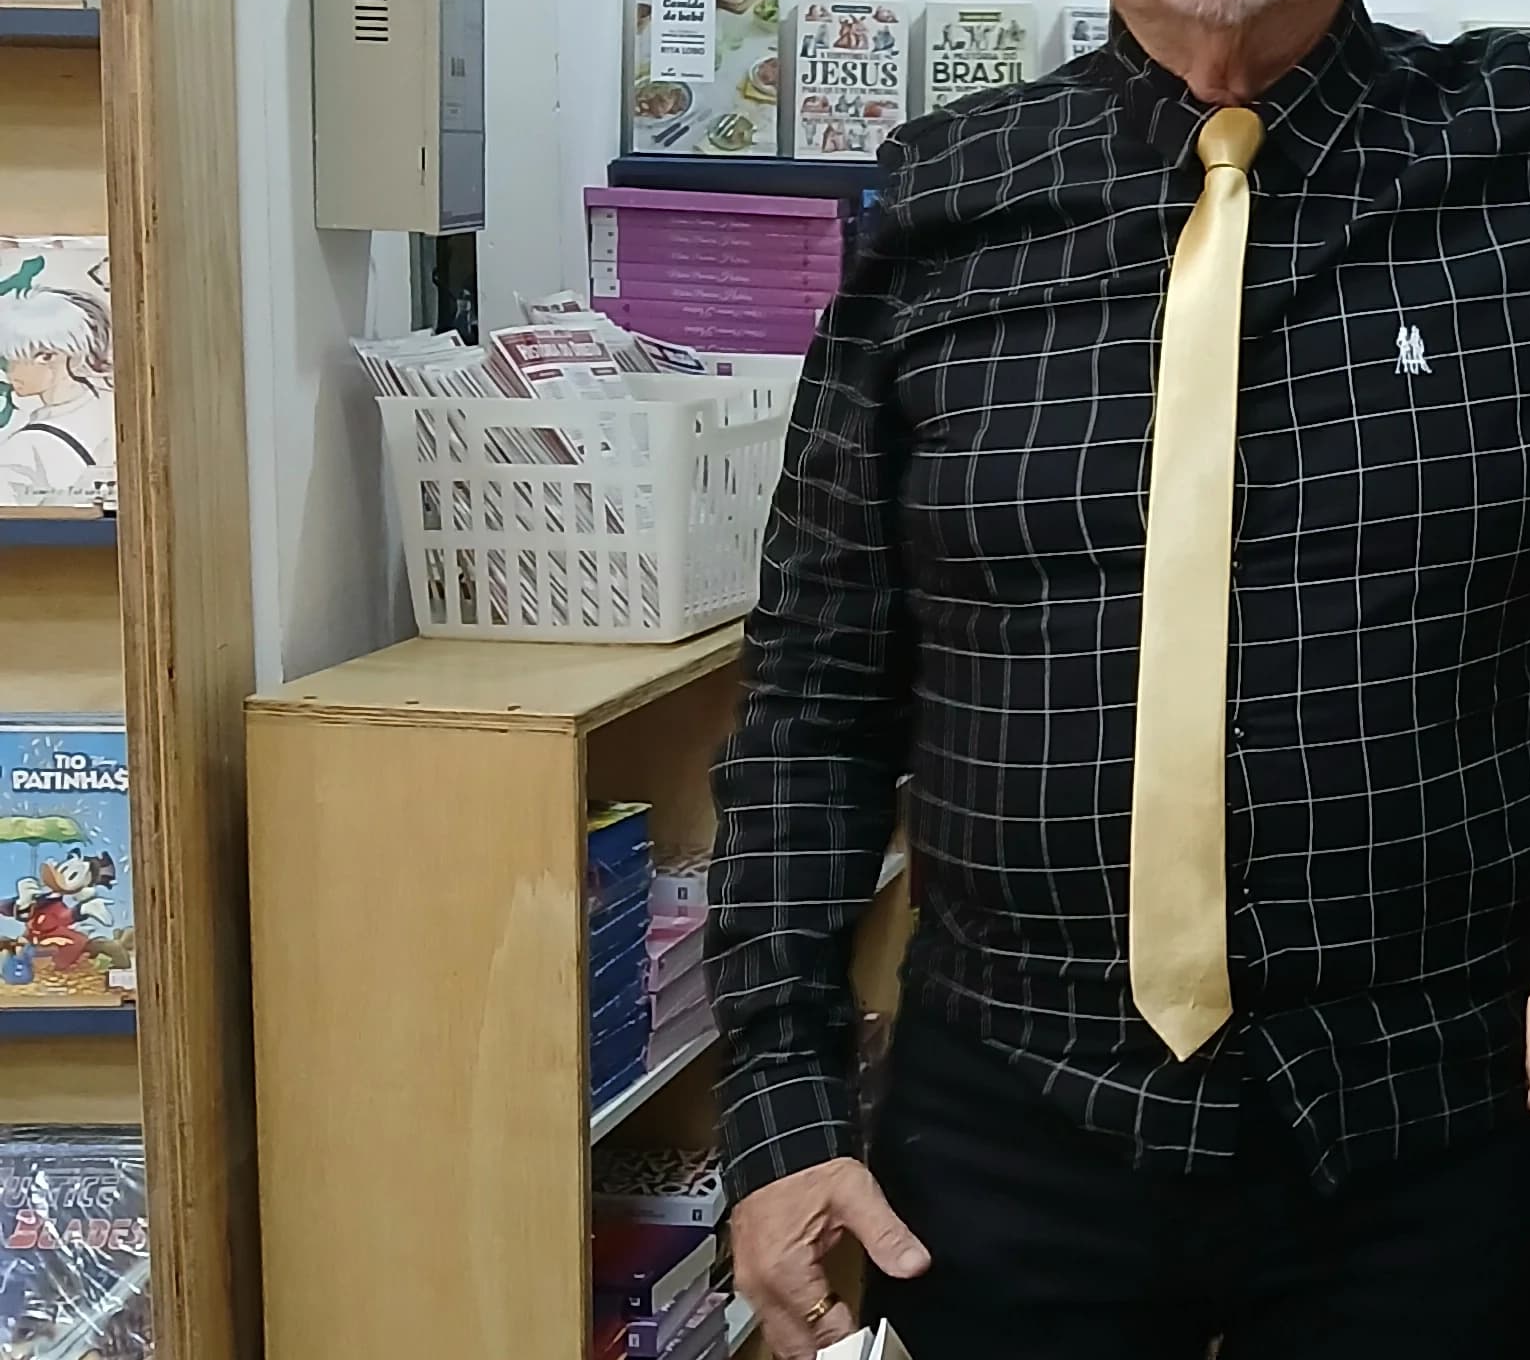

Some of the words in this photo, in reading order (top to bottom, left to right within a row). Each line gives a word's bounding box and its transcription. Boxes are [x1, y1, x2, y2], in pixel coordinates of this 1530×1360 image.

[801, 60, 899, 87] JESUS
[932, 61, 1025, 84] BRASIL
[54, 752, 87, 771] TIO
